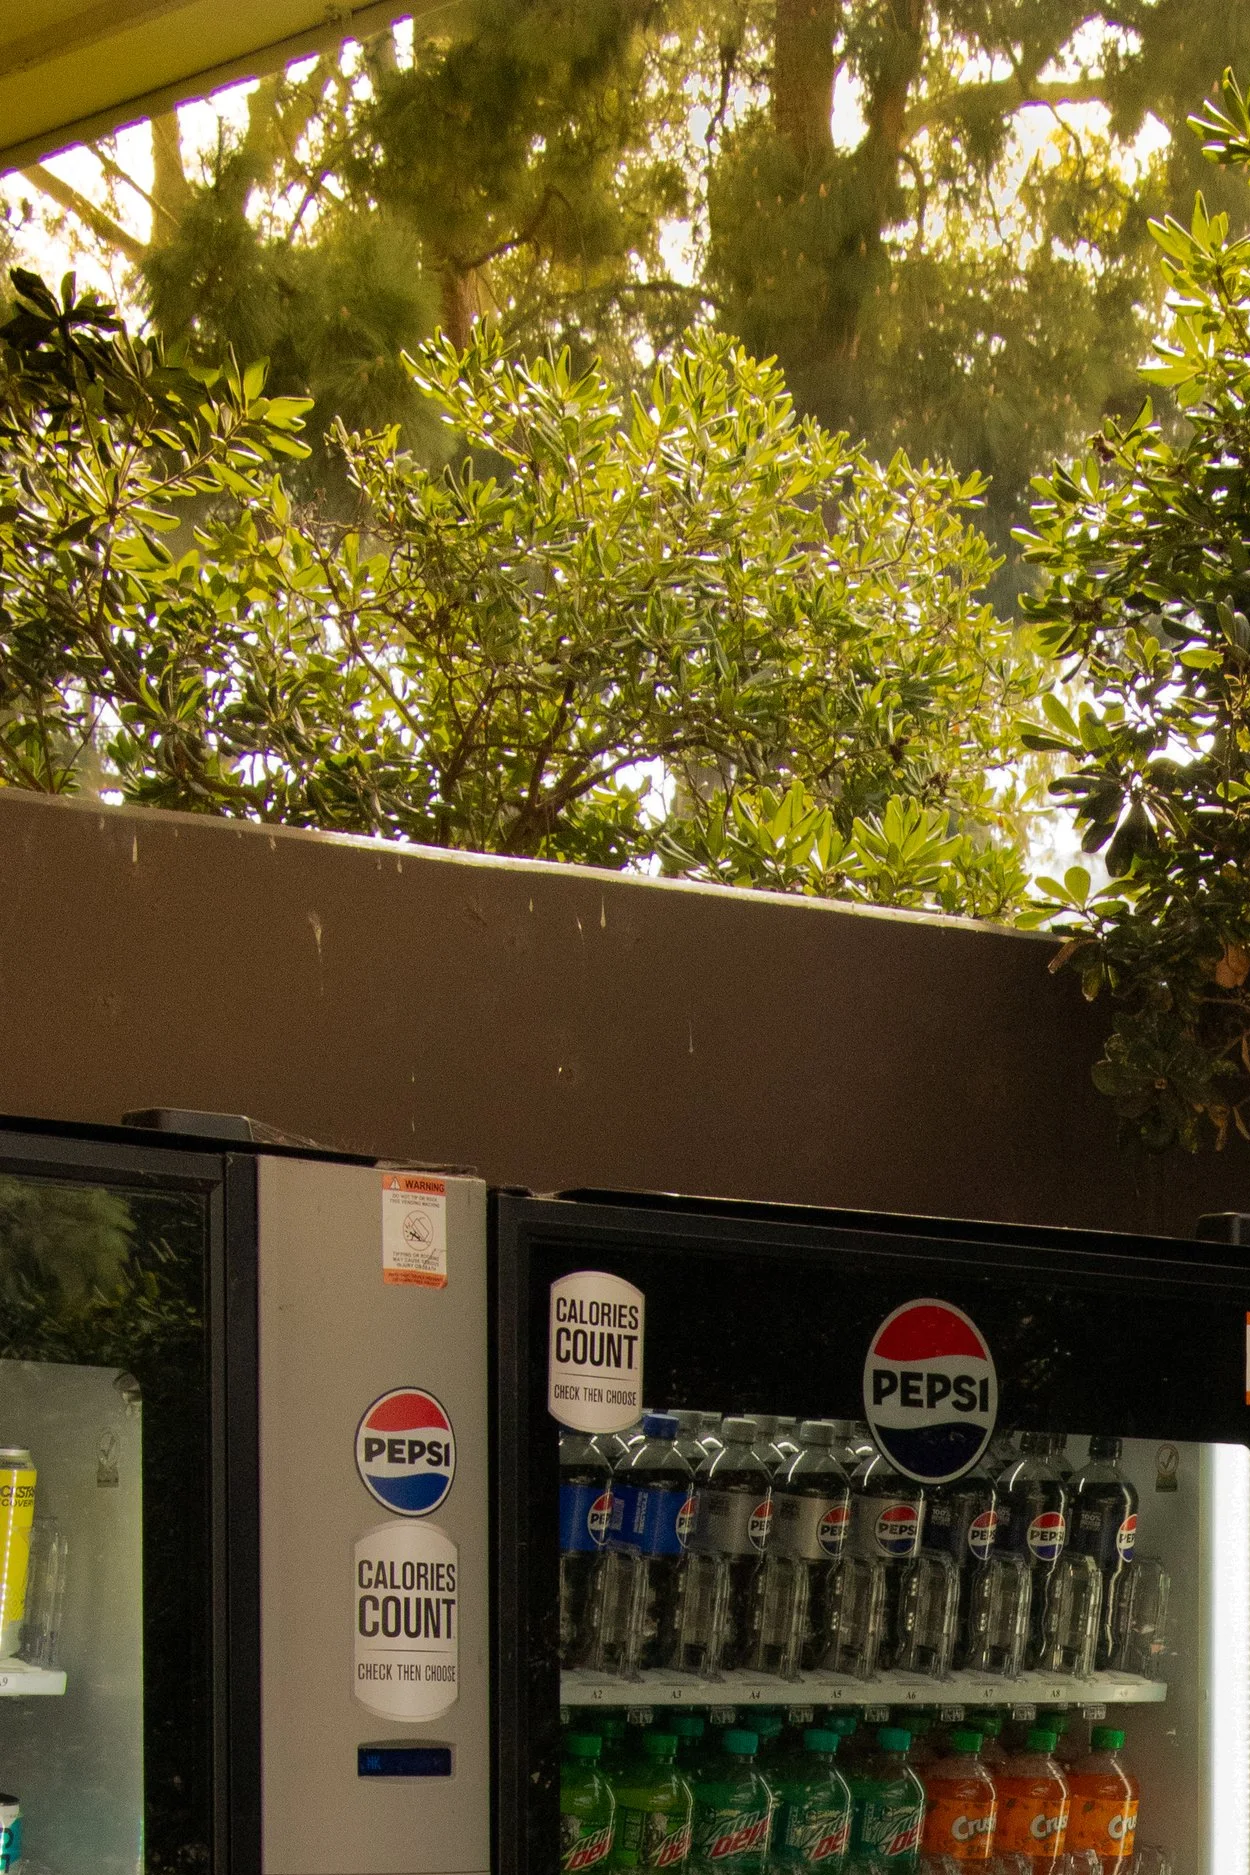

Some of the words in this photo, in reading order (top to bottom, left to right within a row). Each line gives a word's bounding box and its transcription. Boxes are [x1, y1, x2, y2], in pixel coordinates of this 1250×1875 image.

[405, 1180, 445, 1193] WARNING
[556, 1297, 638, 1330] CALORIES
[556, 1327, 638, 1369] COUNT
[554, 1384, 580, 1400] CHECK
[584, 1387, 603, 1403] THEN
[606, 1389, 636, 1406] CHOOSE
[873, 1368, 989, 1414] PEPSI
[364, 1437, 450, 1467] PEPSI
[358, 1560, 456, 1593] CALORIES
[359, 1595, 456, 1640] COUNT
[358, 1663, 392, 1681] CHECK
[397, 1664, 421, 1681] THEN
[425, 1664, 456, 1683] CHOOSE
[593, 1690, 603, 1700] A2
[672, 1691, 682, 1700] A3
[750, 1691, 761, 1700] A4
[832, 1690, 842, 1699] A5
[906, 1691, 916, 1700] A6
[983, 1689, 993, 1698] A7
[1050, 1689, 1060, 1698] A8
